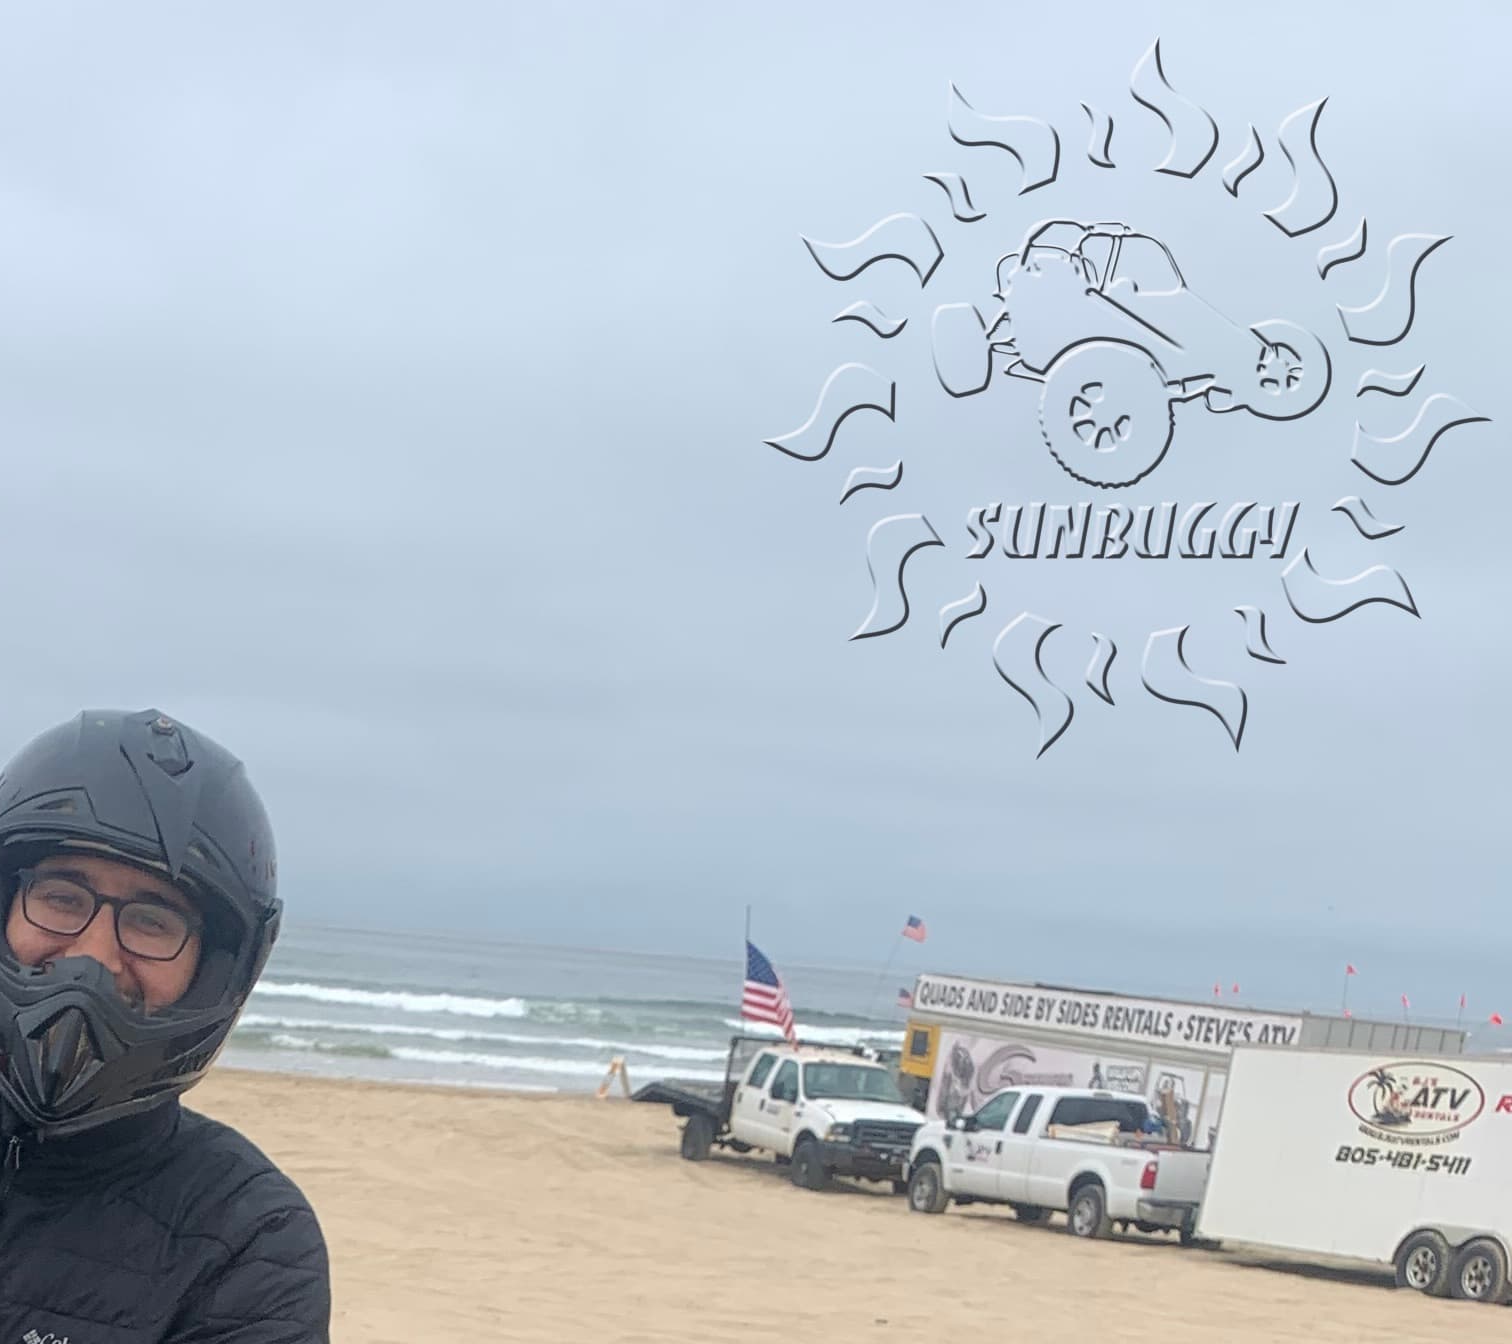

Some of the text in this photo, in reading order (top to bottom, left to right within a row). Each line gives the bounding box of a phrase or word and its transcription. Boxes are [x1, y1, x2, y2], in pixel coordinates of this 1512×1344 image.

[920, 982, 965, 1009] QUADS
[966, 989, 998, 1013] AND
[999, 992, 1032, 1019] SIDE
[1034, 998, 1056, 1022] BY
[1056, 1000, 1100, 1027] SIDES
[1102, 1004, 1174, 1038] RENTALS
[1183, 1014, 1253, 1045] STEVE'S
[1409, 1087, 1471, 1111] ATV
